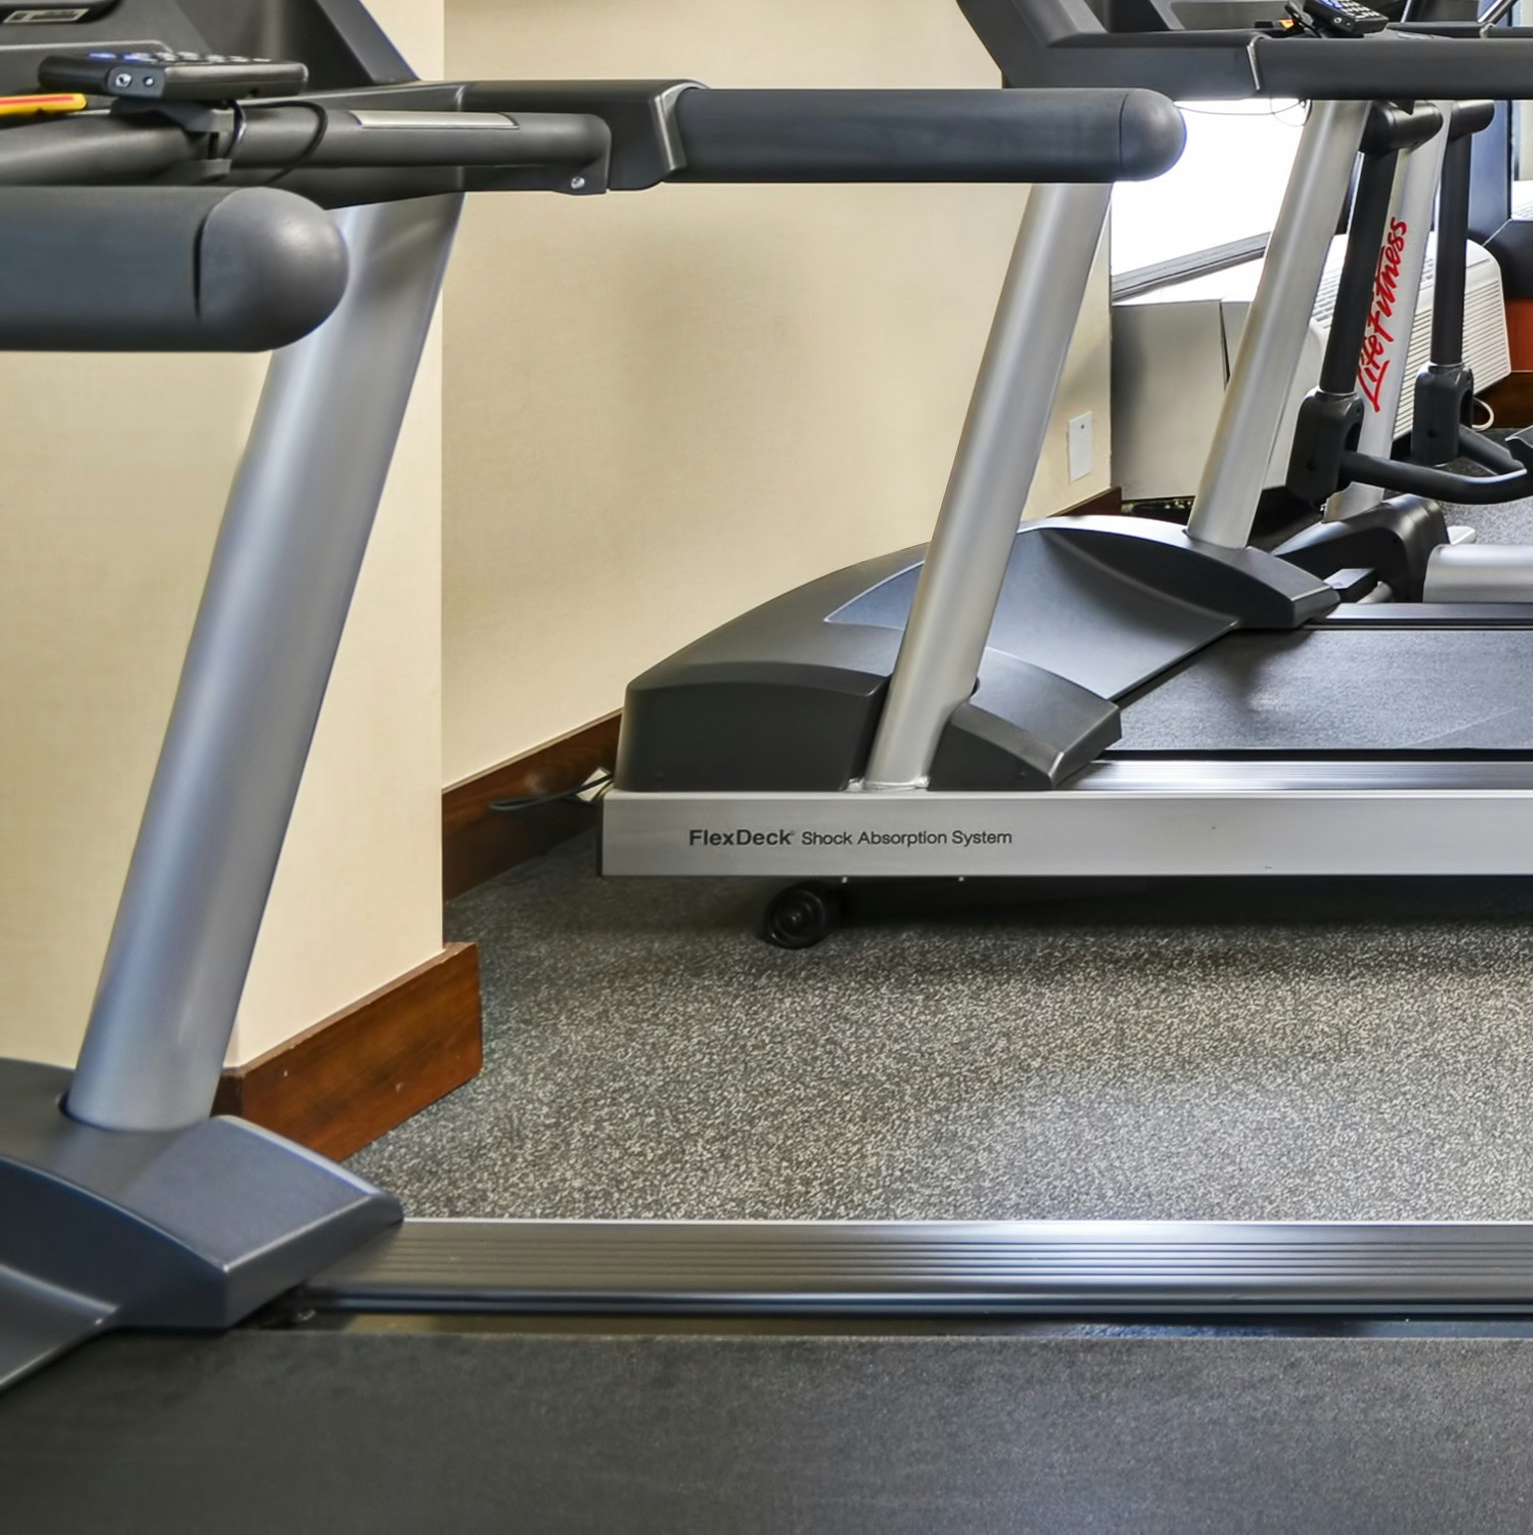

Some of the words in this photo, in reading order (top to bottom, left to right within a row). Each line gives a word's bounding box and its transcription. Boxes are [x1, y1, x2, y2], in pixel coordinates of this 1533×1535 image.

[689, 828, 792, 846] FlexDeck
[801, 831, 853, 846] Shock
[857, 830, 947, 849] Absorption
[951, 830, 1013, 848] System
